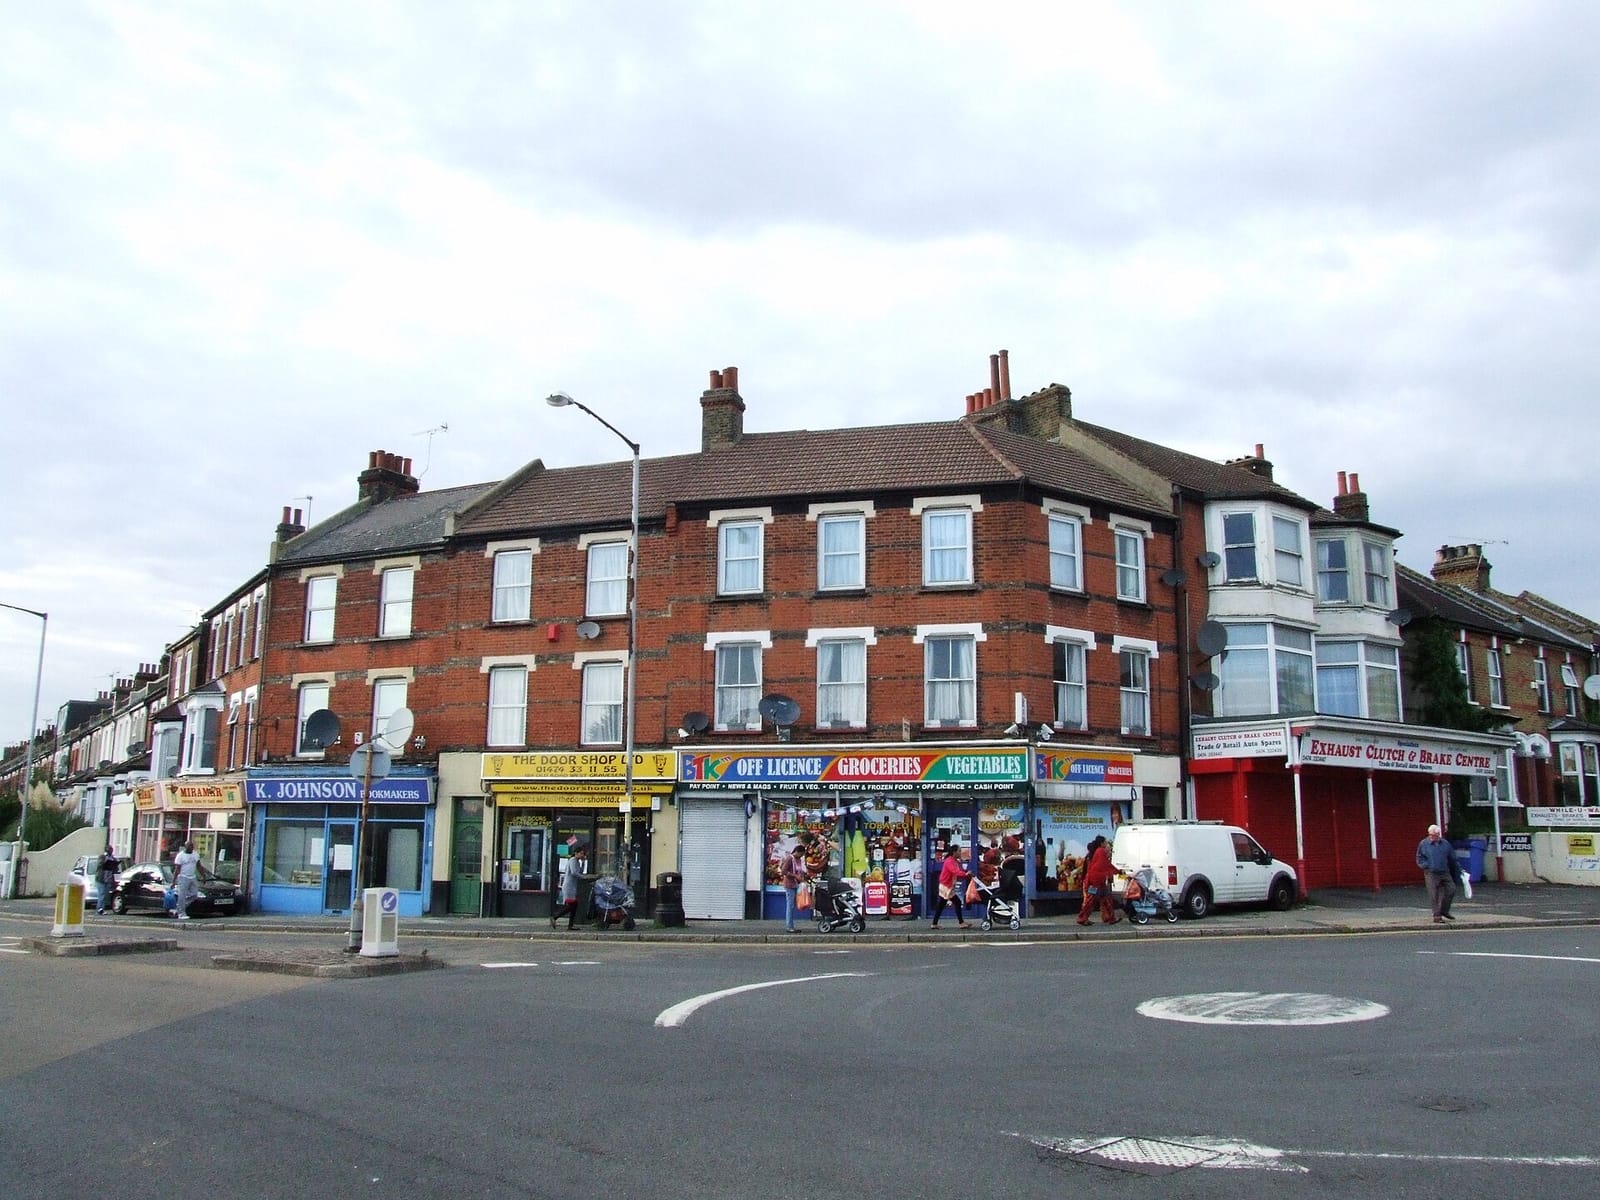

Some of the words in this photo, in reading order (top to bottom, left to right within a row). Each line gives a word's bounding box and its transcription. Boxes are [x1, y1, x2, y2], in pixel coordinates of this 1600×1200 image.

[513, 755, 536, 765] THE
[540, 755, 577, 765] DOOR
[580, 755, 616, 764] SHOP
[620, 754, 644, 764] LD
[1310, 739, 1362, 758] EXHAUST
[1366, 745, 1404, 762] CLUTCH
[1408, 751, 1416, 762] &
[1420, 749, 1452, 766] BRAKE
[1456, 753, 1490, 768] CENTRE
[736, 758, 763, 776] OFF
[767, 758, 822, 776] LICENCE
[837, 757, 921, 776] GROCERIES
[946, 756, 1021, 774] VEGETABLES
[1070, 764, 1082, 774] OFF
[1082, 764, 1104, 774] LICENCE
[1107, 767, 1132, 776] GROCERIES
[255, 783, 272, 798] K.
[276, 782, 356, 798] JOHNSON
[995, 810, 1007, 820] &
